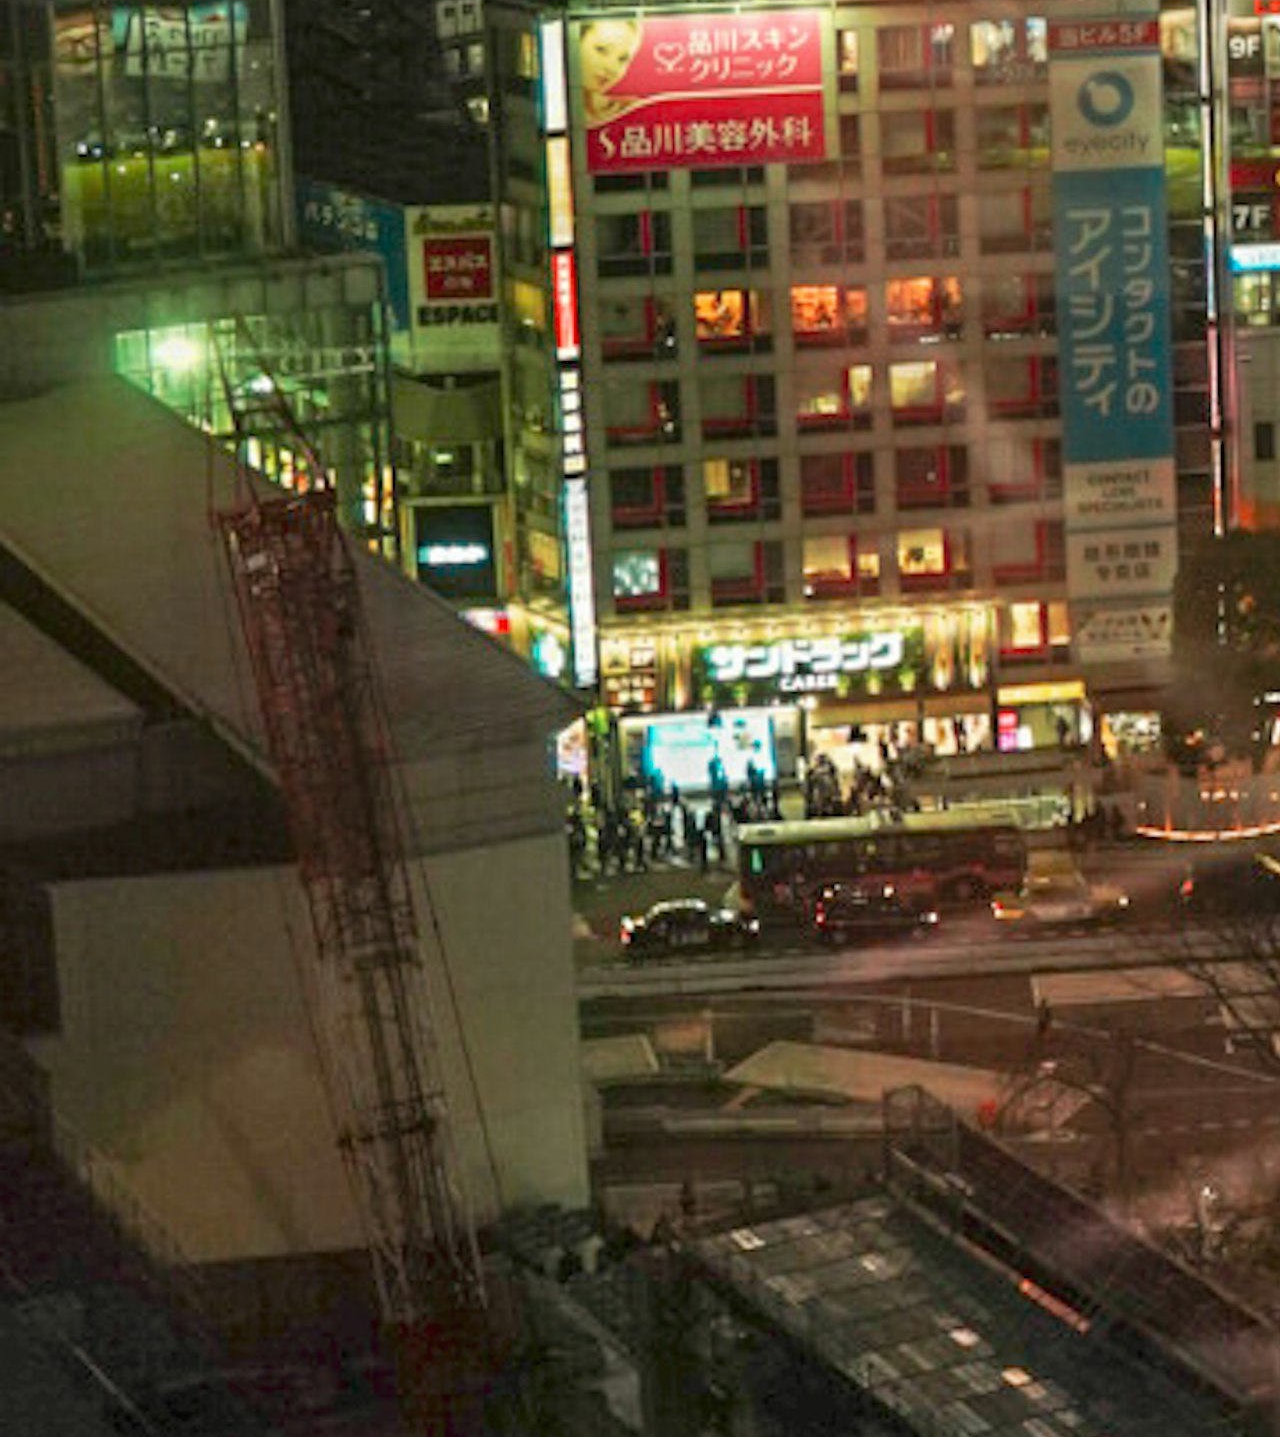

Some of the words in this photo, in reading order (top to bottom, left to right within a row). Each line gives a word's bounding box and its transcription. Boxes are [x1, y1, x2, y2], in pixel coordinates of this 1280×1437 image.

[688, 26, 809, 55] 品川スキン
[1229, 35, 1261, 59] 9F
[690, 55, 799, 83] クリニック
[620, 115, 813, 160] 品川美容外科
[1232, 203, 1271, 230] 7F
[1065, 207, 1118, 418] アイシティ
[1122, 204, 1160, 415] コンタクトの
[709, 632, 905, 681] サンドラッグ
